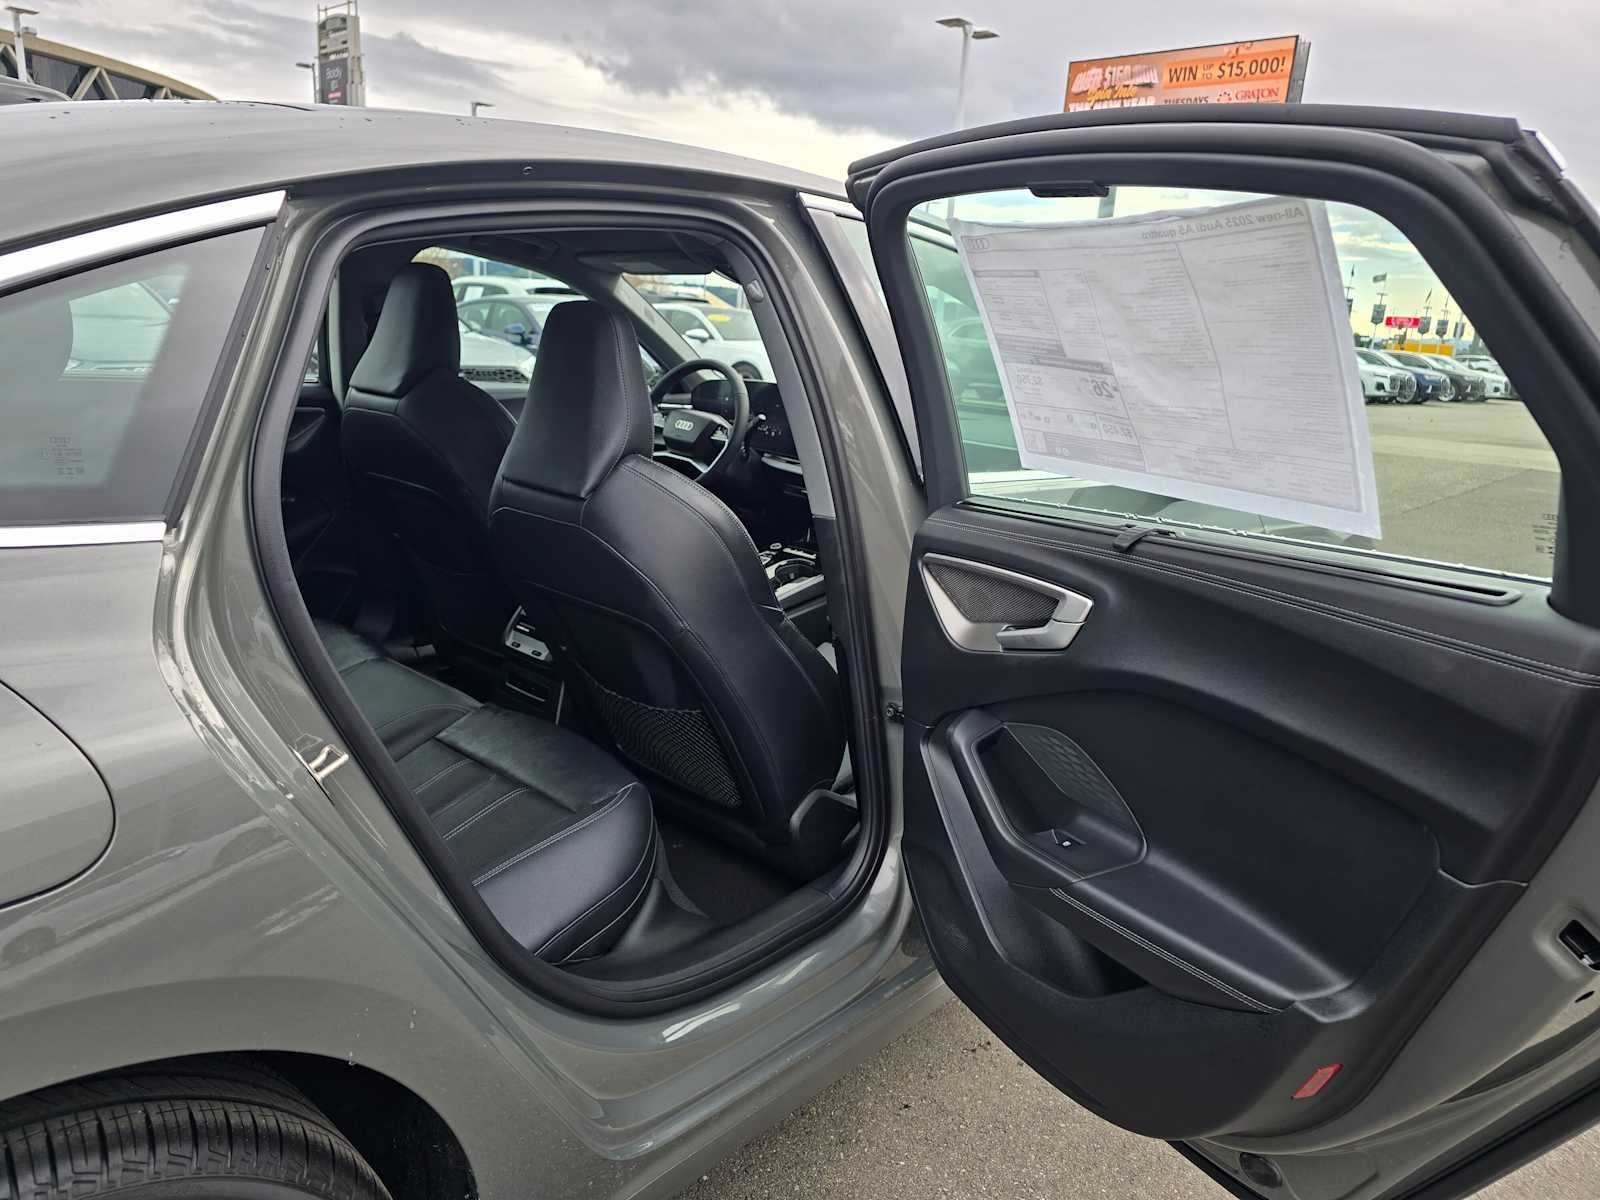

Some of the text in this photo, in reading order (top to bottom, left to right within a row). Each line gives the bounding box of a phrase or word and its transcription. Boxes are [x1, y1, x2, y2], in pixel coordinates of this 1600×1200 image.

[1168, 65, 1199, 84] WIN
[1202, 63, 1215, 72] UP
[1217, 56, 1286, 80] $15,000!
[1235, 87, 1280, 101] GRATON
